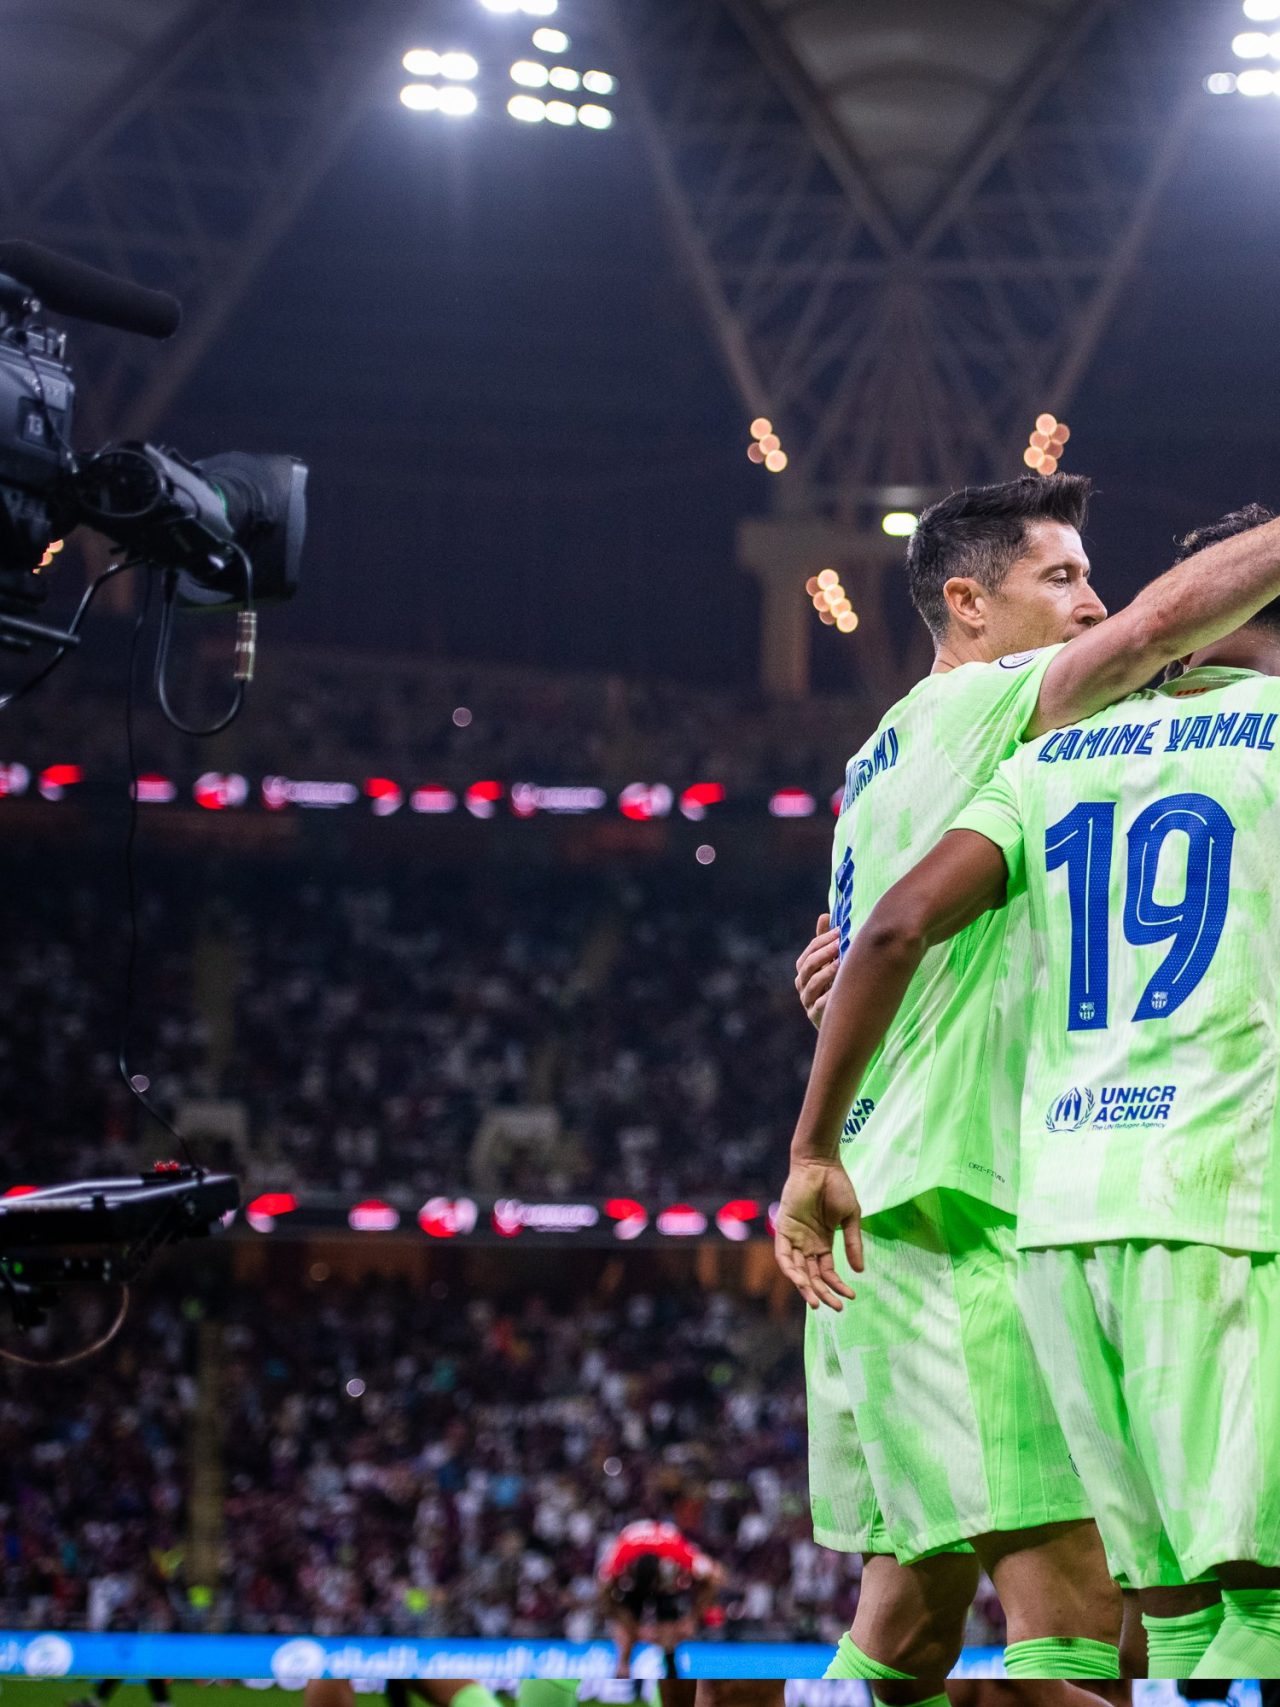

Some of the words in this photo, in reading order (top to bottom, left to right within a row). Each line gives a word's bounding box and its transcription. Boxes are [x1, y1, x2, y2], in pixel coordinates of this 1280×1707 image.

[1037, 719, 1162, 764] LAMINE
[1163, 712, 1279, 753] YAMAL
[1045, 793, 1236, 1031] 19
[1100, 1085, 1177, 1105] UNHCR
[1092, 1104, 1171, 1123] ACNUR
